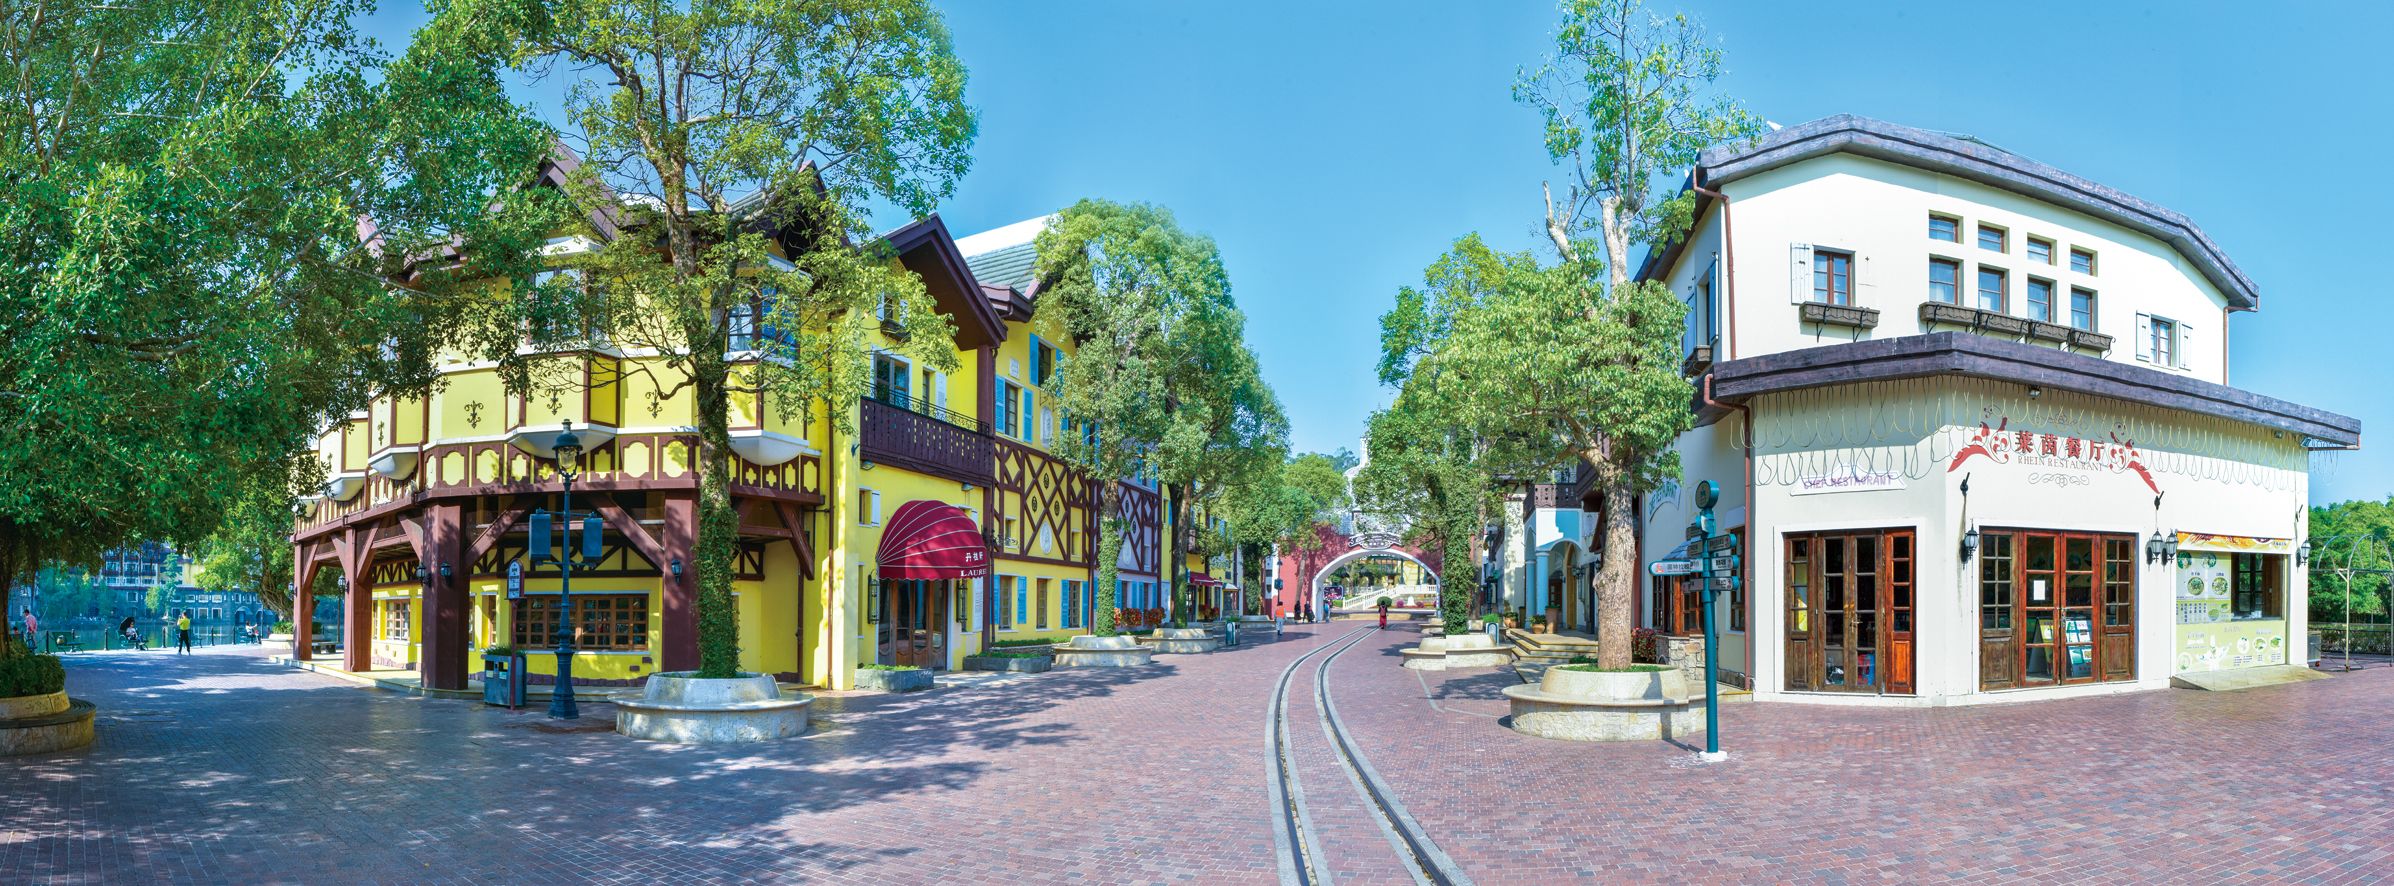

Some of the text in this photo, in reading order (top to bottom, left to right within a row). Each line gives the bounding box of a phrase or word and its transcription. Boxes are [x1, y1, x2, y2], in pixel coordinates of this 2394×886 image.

[2015, 430, 2104, 461] 莱茵餐厅
[2018, 456, 2102, 472] RHEIN RESTAURANT
[1831, 474, 1894, 488] RESTAURANT
